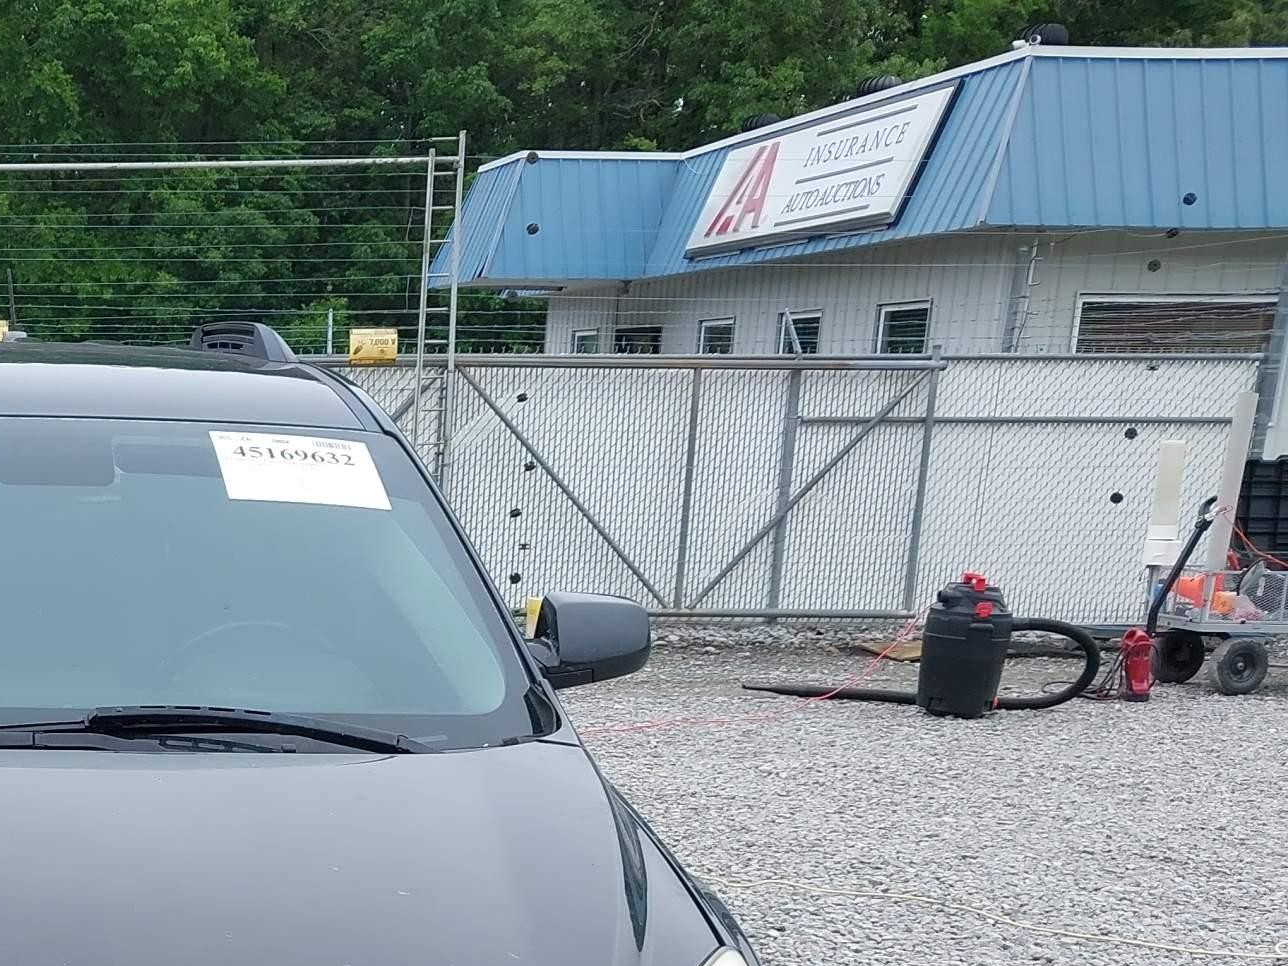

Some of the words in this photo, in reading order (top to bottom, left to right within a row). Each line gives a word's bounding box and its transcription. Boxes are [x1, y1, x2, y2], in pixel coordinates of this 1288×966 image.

[803, 121, 911, 168] INSURANCE
[781, 188, 820, 214] AUTO
[814, 173, 886, 207] AUCTIONS
[232, 445, 355, 466] 45169632
